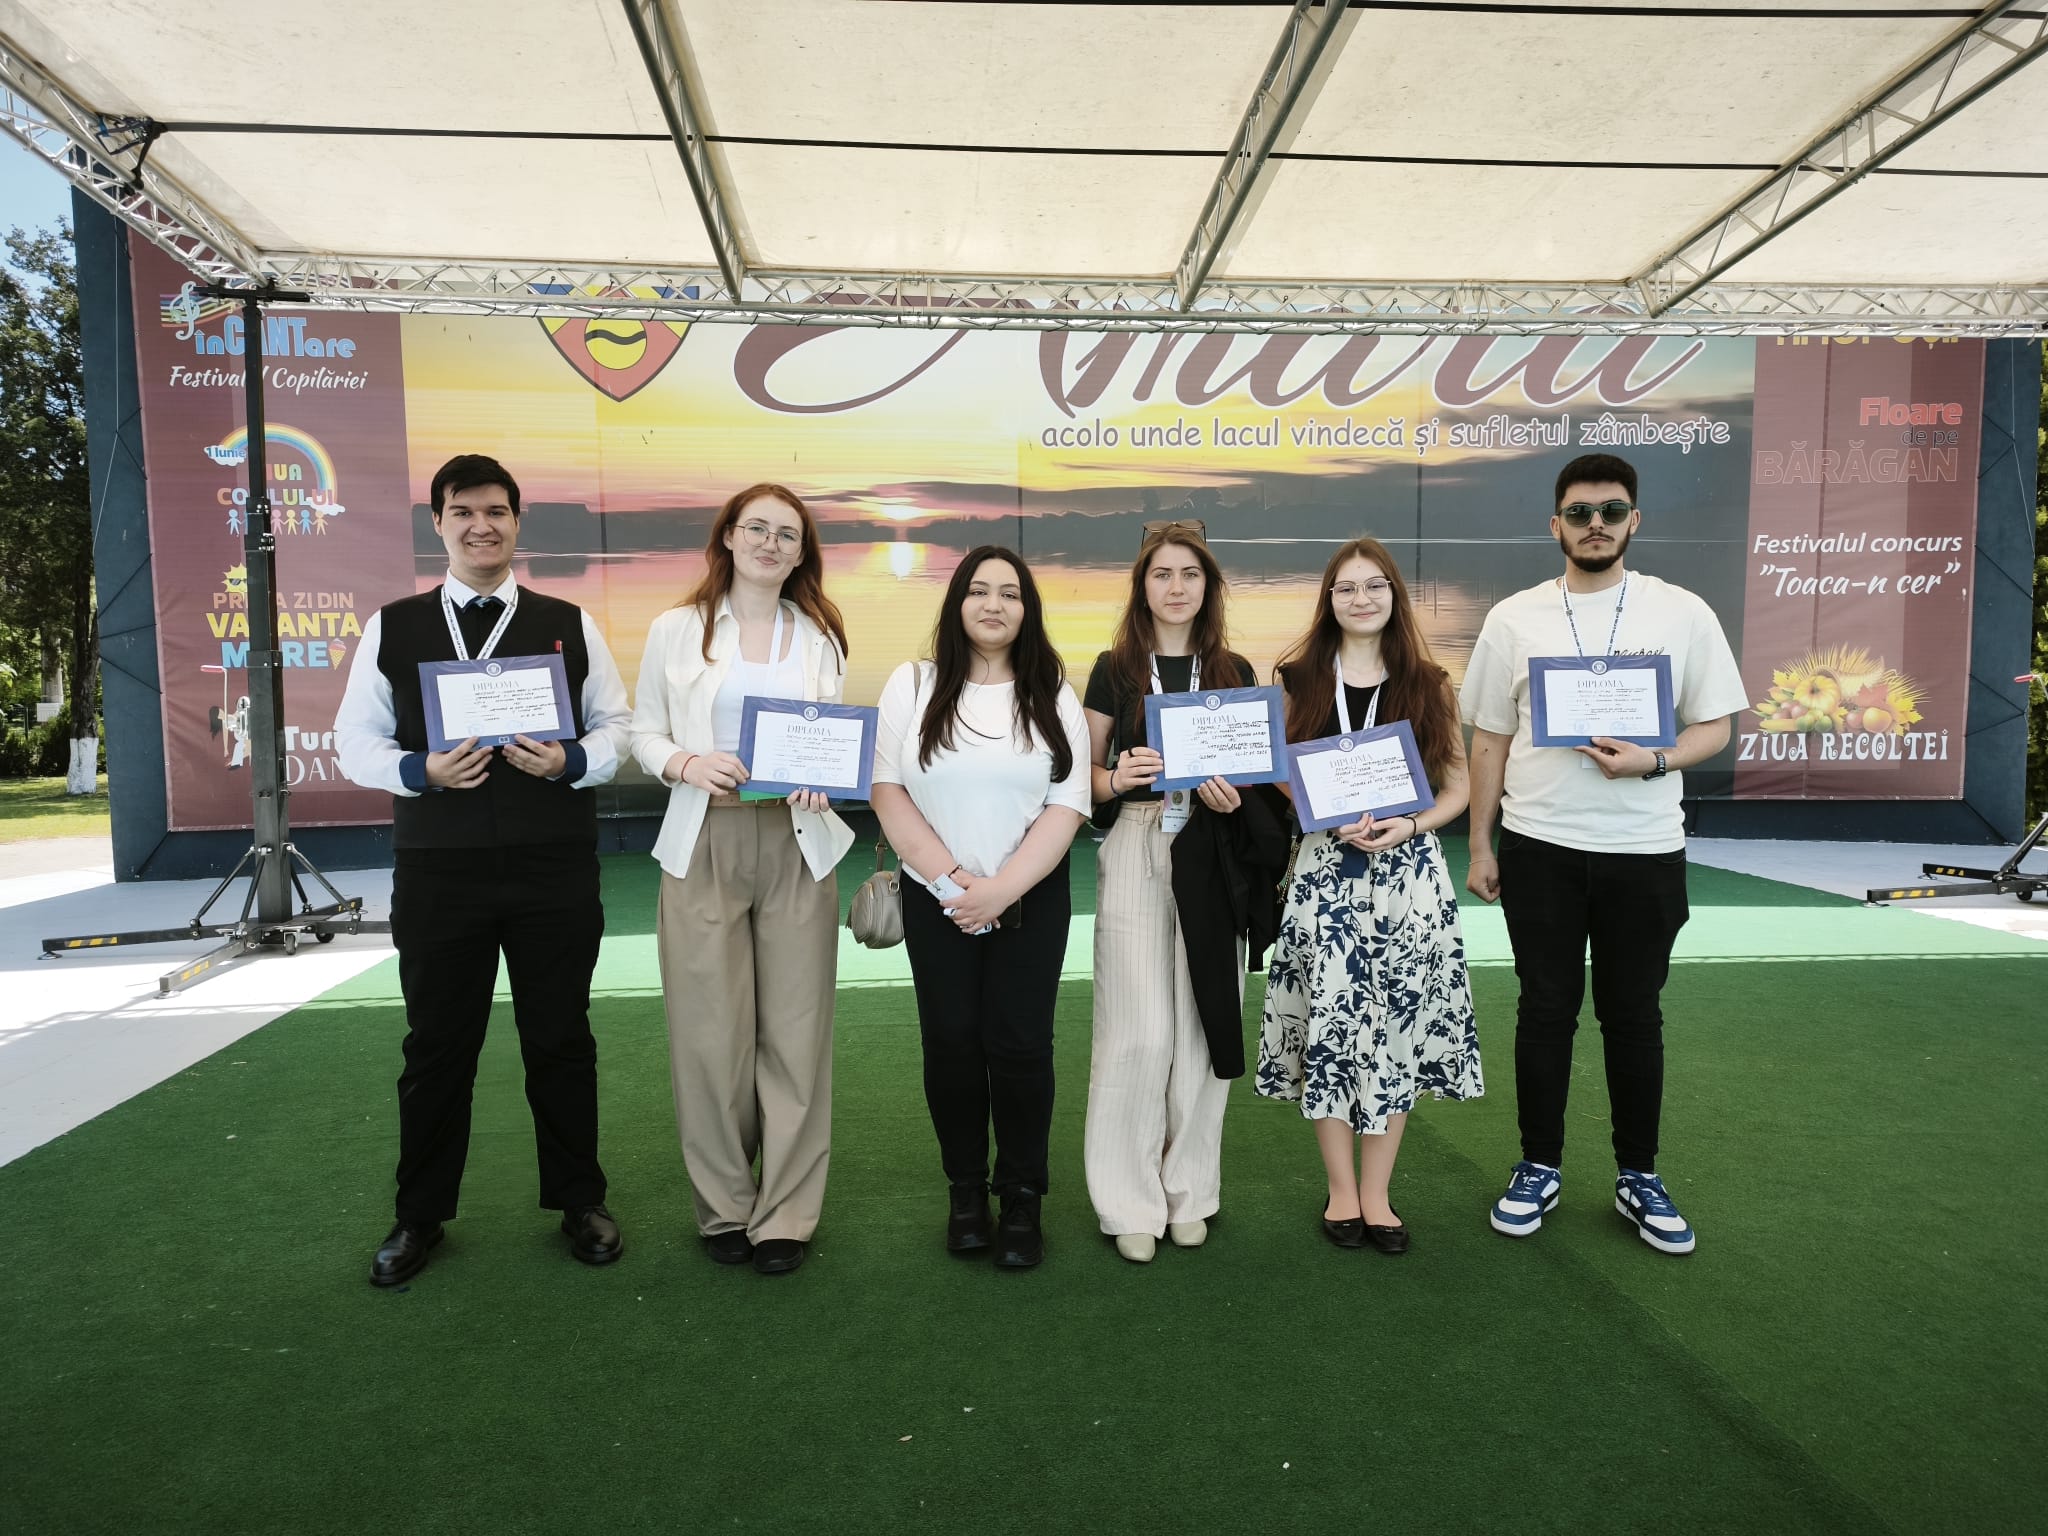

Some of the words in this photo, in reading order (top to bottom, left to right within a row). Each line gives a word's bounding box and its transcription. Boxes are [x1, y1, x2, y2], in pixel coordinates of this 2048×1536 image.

[194, 315, 357, 358] înCNTare
[169, 365, 270, 388] Festivall
[272, 366, 368, 395] Copilăriei
[1859, 397, 1963, 426] Floare
[1041, 417, 1119, 447] acolo
[1130, 416, 1202, 447] unde
[1212, 416, 1279, 447] lacul
[1290, 416, 1404, 447] vindecă
[1414, 417, 1439, 456] și
[1448, 414, 1570, 448] sufletul
[1579, 412, 1730, 454] zâmbește
[1901, 426, 1927, 446] de
[1933, 427, 1958, 447] pe
[266, 464, 302, 480] IUA
[1755, 440, 1958, 485] BĂRĂGAN
[217, 488, 334, 506] COLULUI
[1753, 532, 1867, 554] Festivalul
[1870, 535, 1962, 553] concurs
[213, 592, 288, 609] PRIA
[294, 592, 312, 609] ZI
[317, 592, 354, 609] DIN
[205, 612, 362, 638] VAANTA
[221, 641, 329, 668] MRE
[472, 679, 520, 691] DIPLOMA
[1577, 680, 1624, 688] DIPLOMA
[1192, 714, 1238, 725] DIPLOMA
[787, 725, 832, 737] DIPLOMA
[1329, 753, 1373, 768] DIPLOMA
